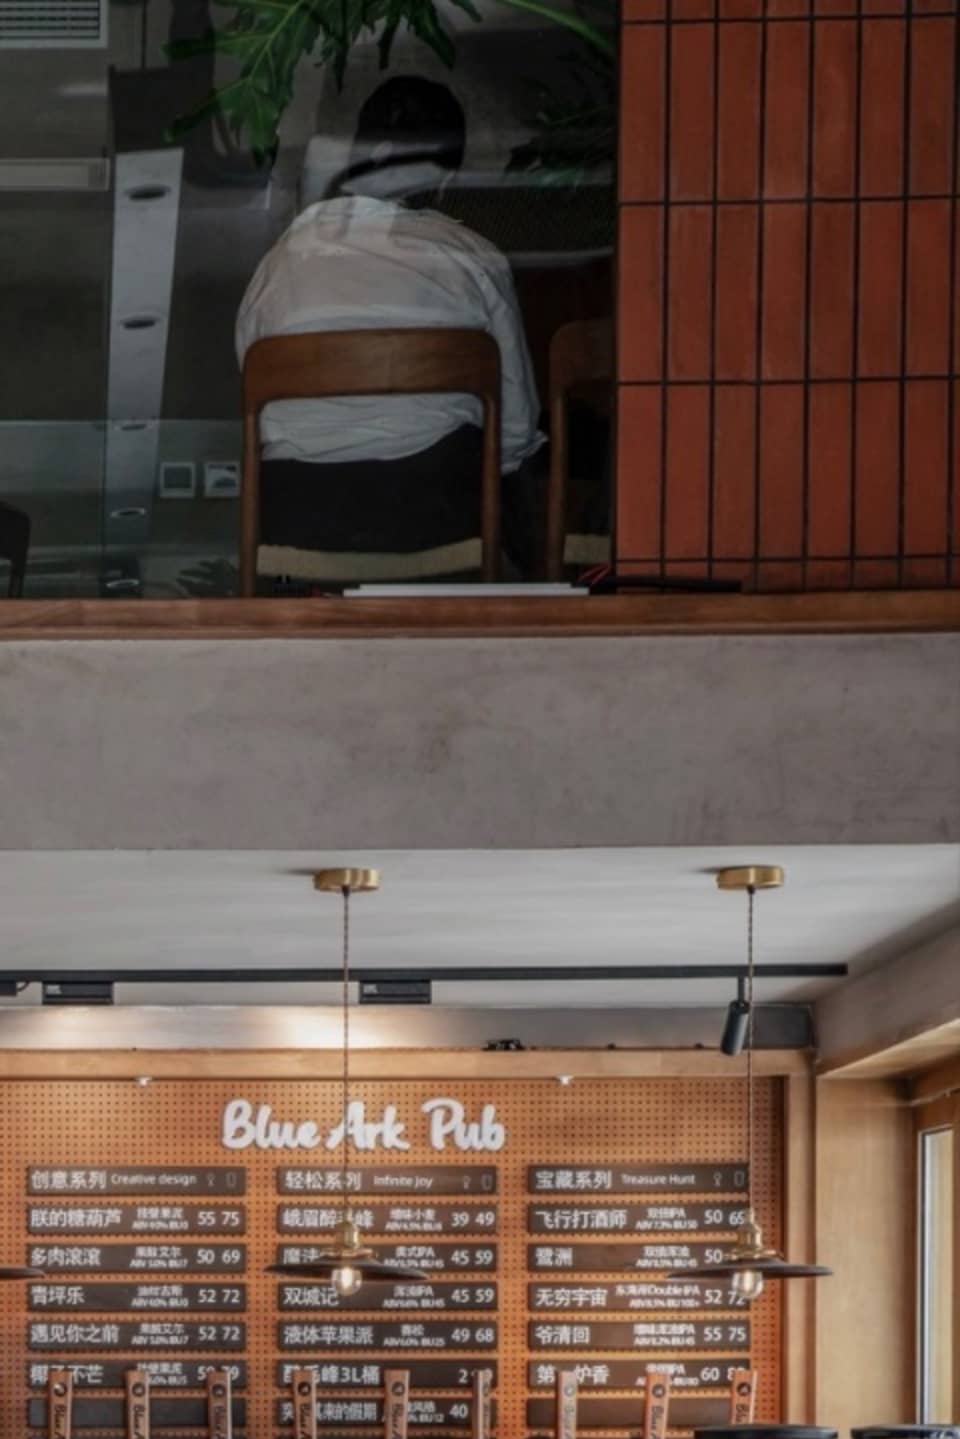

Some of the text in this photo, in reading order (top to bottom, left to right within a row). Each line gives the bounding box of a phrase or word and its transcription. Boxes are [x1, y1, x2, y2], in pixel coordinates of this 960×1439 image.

[222, 1097, 506, 1151] Blue Ark Pub
[31, 1169, 197, 1190] 创意系列 Creative design
[284, 1171, 362, 1191] 轻松系列
[373, 1174, 414, 1188] Infinite
[535, 1170, 696, 1190] 宝藏系列 Treasure Hunt
[197, 1211, 216, 1226] 55
[221, 1211, 240, 1226] 75
[451, 1212, 470, 1228] 39
[474, 1211, 495, 1227] 49
[704, 1208, 724, 1225] 50
[196, 1248, 215, 1264] 50
[221, 1248, 241, 1264] 69
[451, 1249, 470, 1265] 45
[474, 1249, 494, 1265] 59
[704, 1248, 724, 1264] 50
[197, 1288, 217, 1304] 52
[221, 1288, 240, 1304] 72
[451, 1288, 470, 1304] 45
[474, 1288, 495, 1304] 59
[535, 1288, 608, 1308] 无穷宇宙
[704, 1288, 722, 1305] 52
[31, 1323, 120, 1344] 遇见你之前
[197, 1326, 217, 1342] 52
[221, 1326, 240, 1342] 72
[451, 1328, 471, 1344] 49
[474, 1328, 495, 1344] 68
[703, 1326, 723, 1342] 55
[727, 1326, 747, 1342] 75
[30, 1364, 103, 1385] 椰不芒
[536, 1365, 610, 1385] 第炉香
[700, 1367, 720, 1382] 60
[450, 1403, 469, 1418] 40
